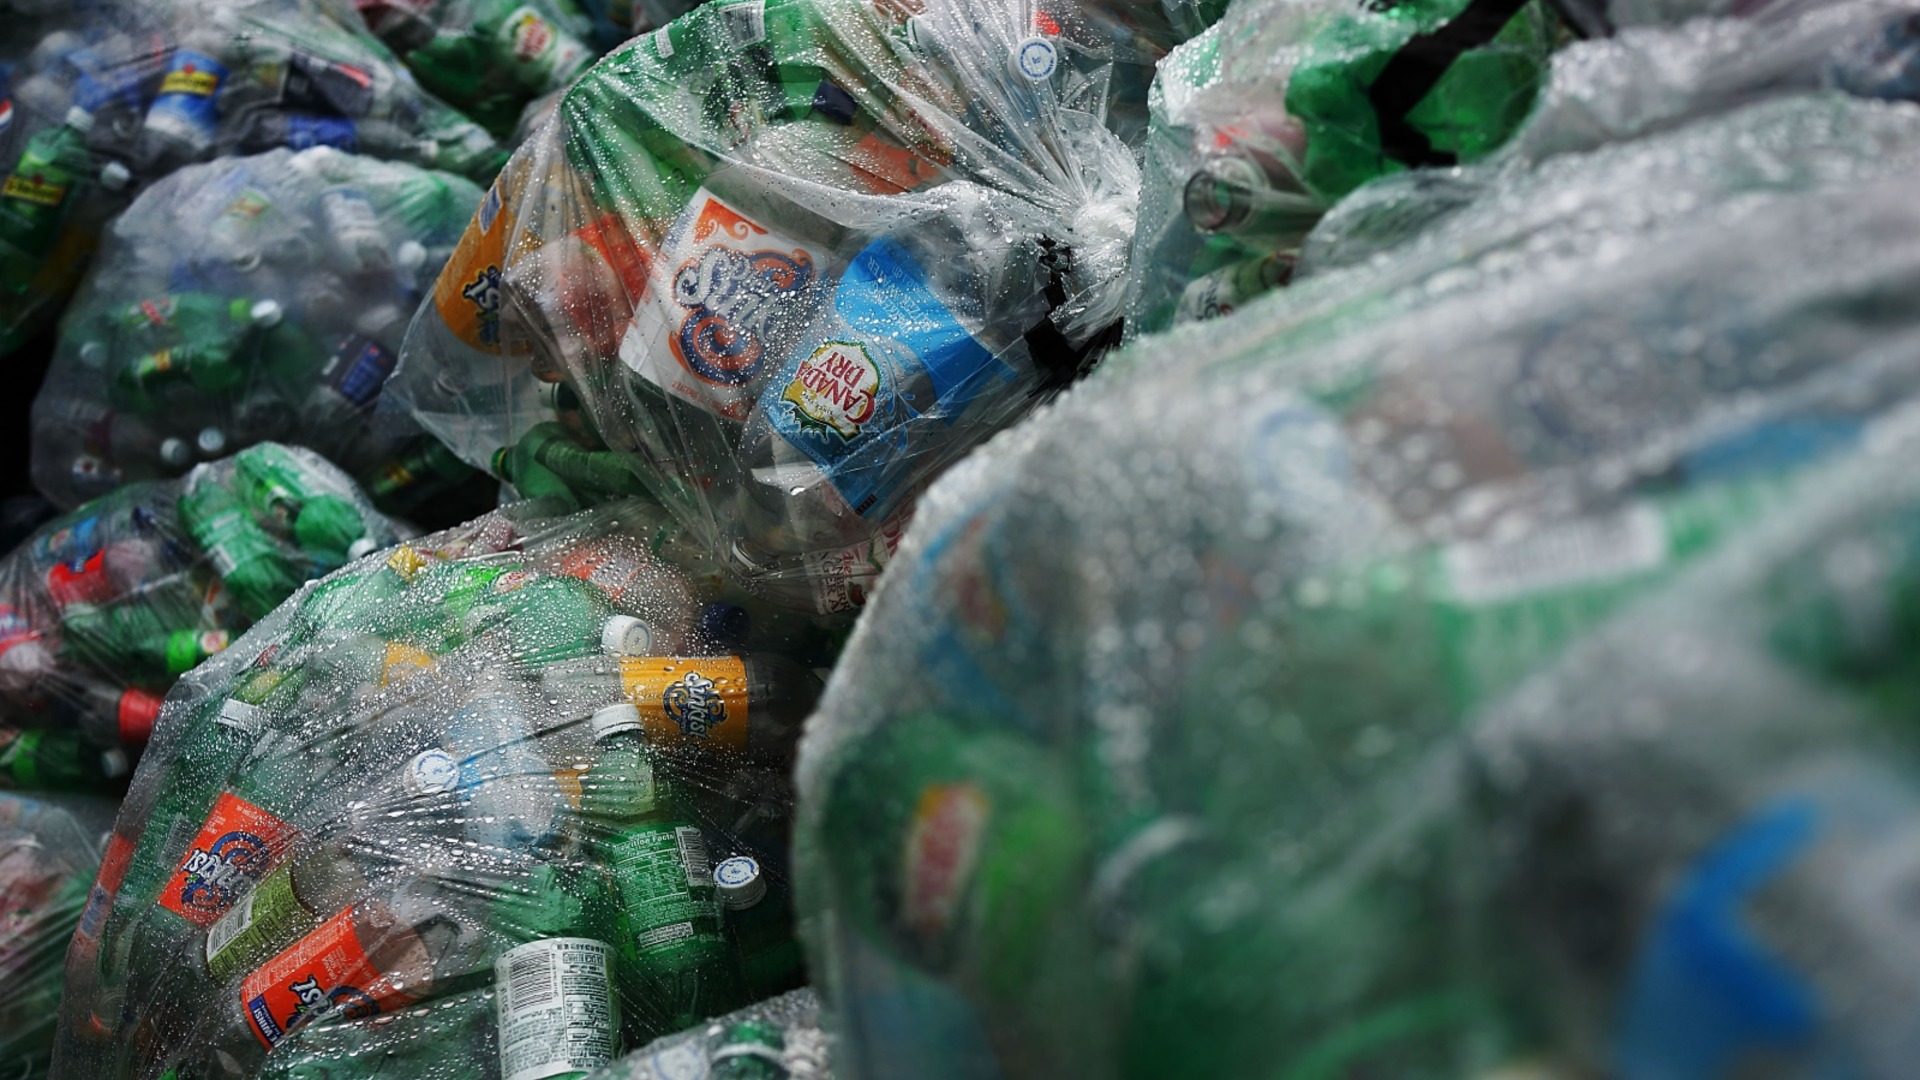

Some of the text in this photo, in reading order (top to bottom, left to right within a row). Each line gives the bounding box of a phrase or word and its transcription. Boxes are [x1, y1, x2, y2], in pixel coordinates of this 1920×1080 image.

[674, 250, 790, 345] Sunk
[867, 256, 900, 300] WATER
[795, 360, 875, 424] CANADA
[820, 351, 866, 388] DRY
[684, 672, 713, 740] Sunkist
[253, 1008, 273, 1037] WINS!
